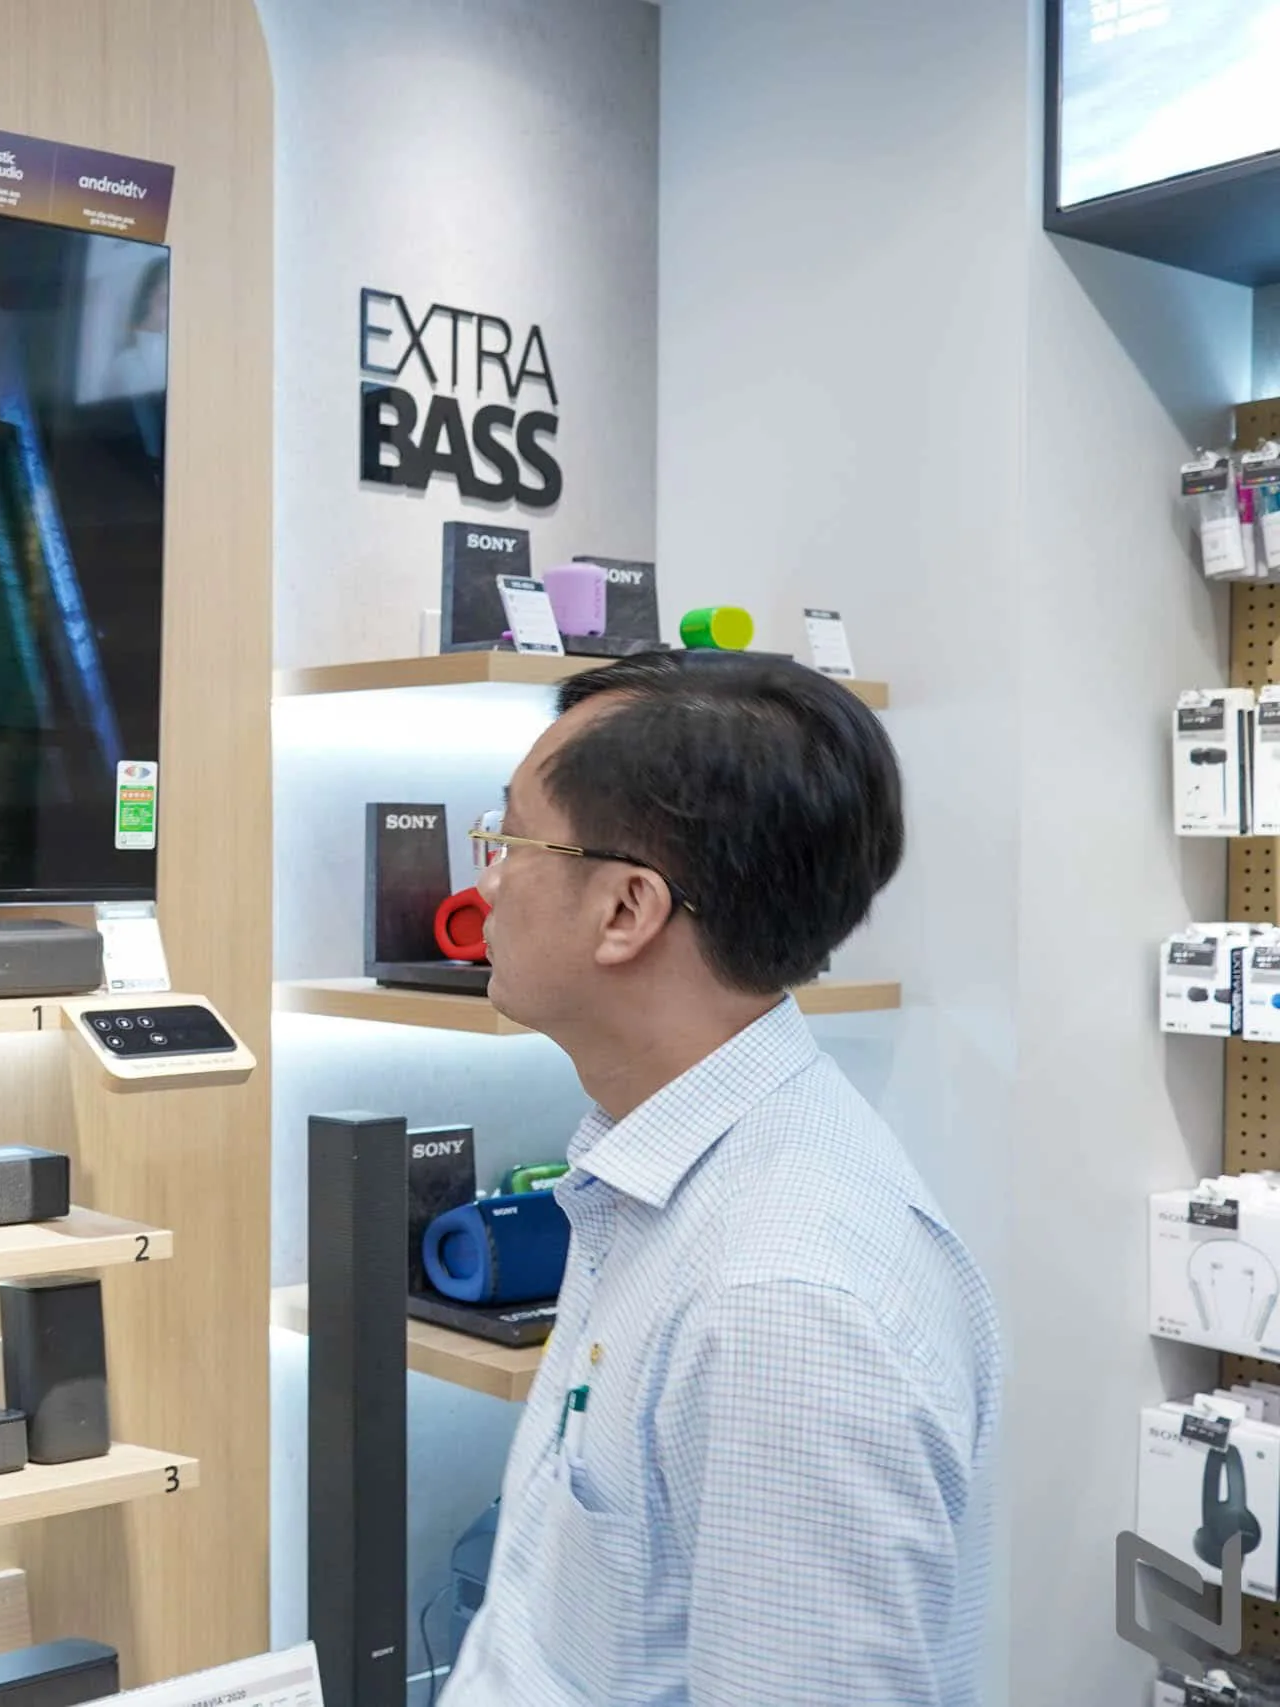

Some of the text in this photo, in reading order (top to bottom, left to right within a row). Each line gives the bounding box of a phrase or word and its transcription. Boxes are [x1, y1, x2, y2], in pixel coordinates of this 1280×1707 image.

[360, 287, 559, 406] EXTRA
[360, 380, 563, 508] BASS
[466, 533, 516, 553] SONY
[385, 814, 437, 830] SONY
[32, 1005, 43, 1031] 1
[412, 1138, 464, 1159] SONY
[492, 1206, 519, 1217] SONY
[135, 1236, 149, 1262] 2
[164, 1466, 180, 1493] 3
